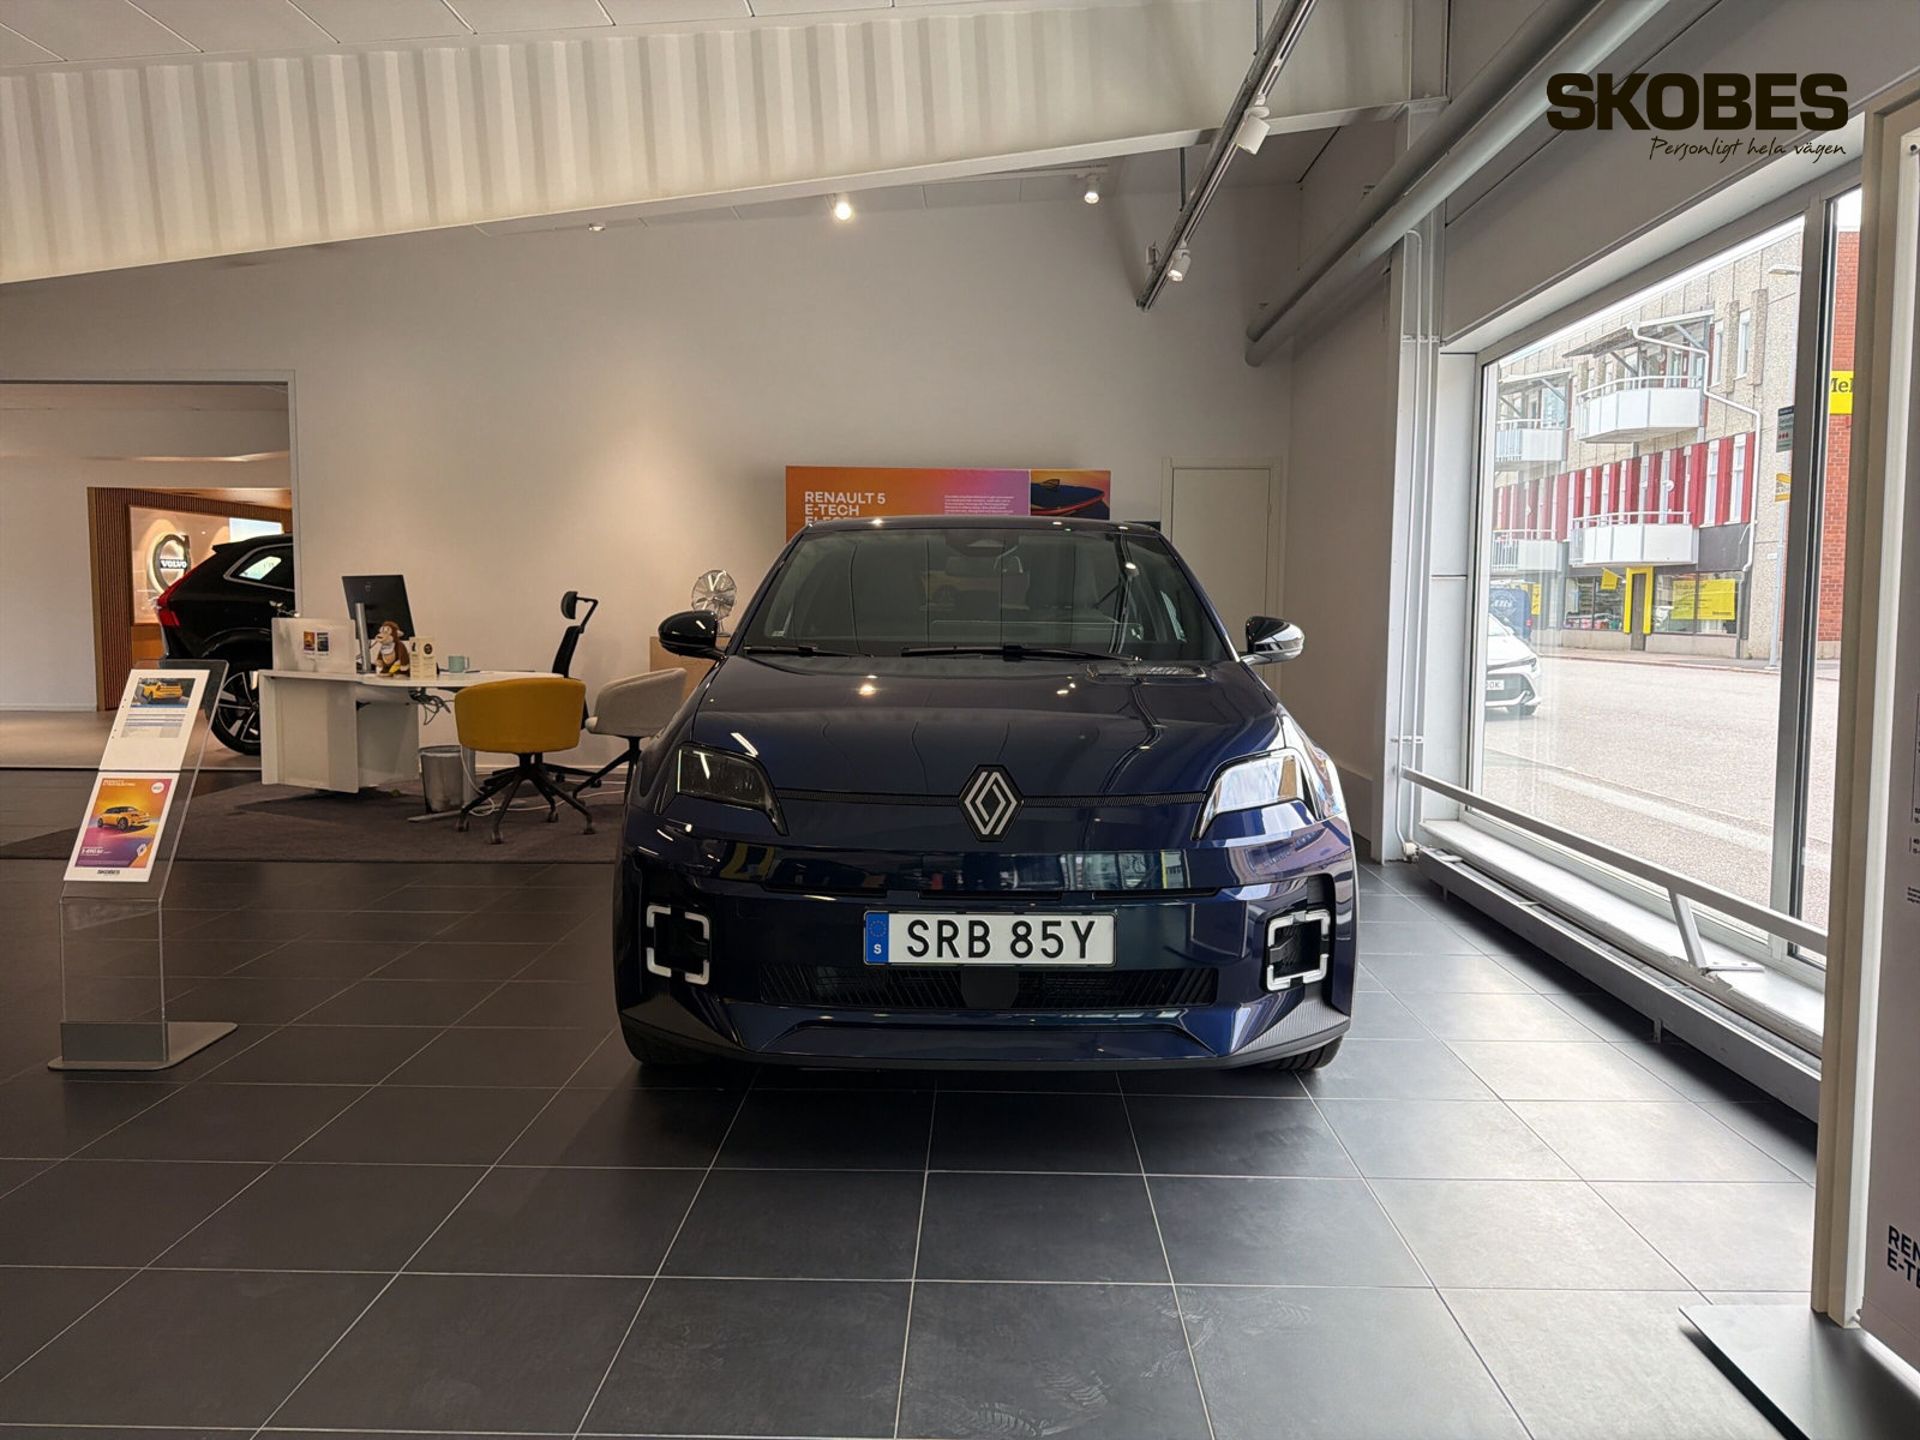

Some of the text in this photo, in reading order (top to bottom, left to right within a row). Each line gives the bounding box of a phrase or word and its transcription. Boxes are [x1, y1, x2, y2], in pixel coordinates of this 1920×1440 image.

[804, 491, 886, 504] RENAULT 5
[804, 504, 860, 516] E-TECH
[161, 560, 187, 568] VOLVO
[907, 919, 1096, 959] SRB 85Y
[873, 944, 882, 954] S
